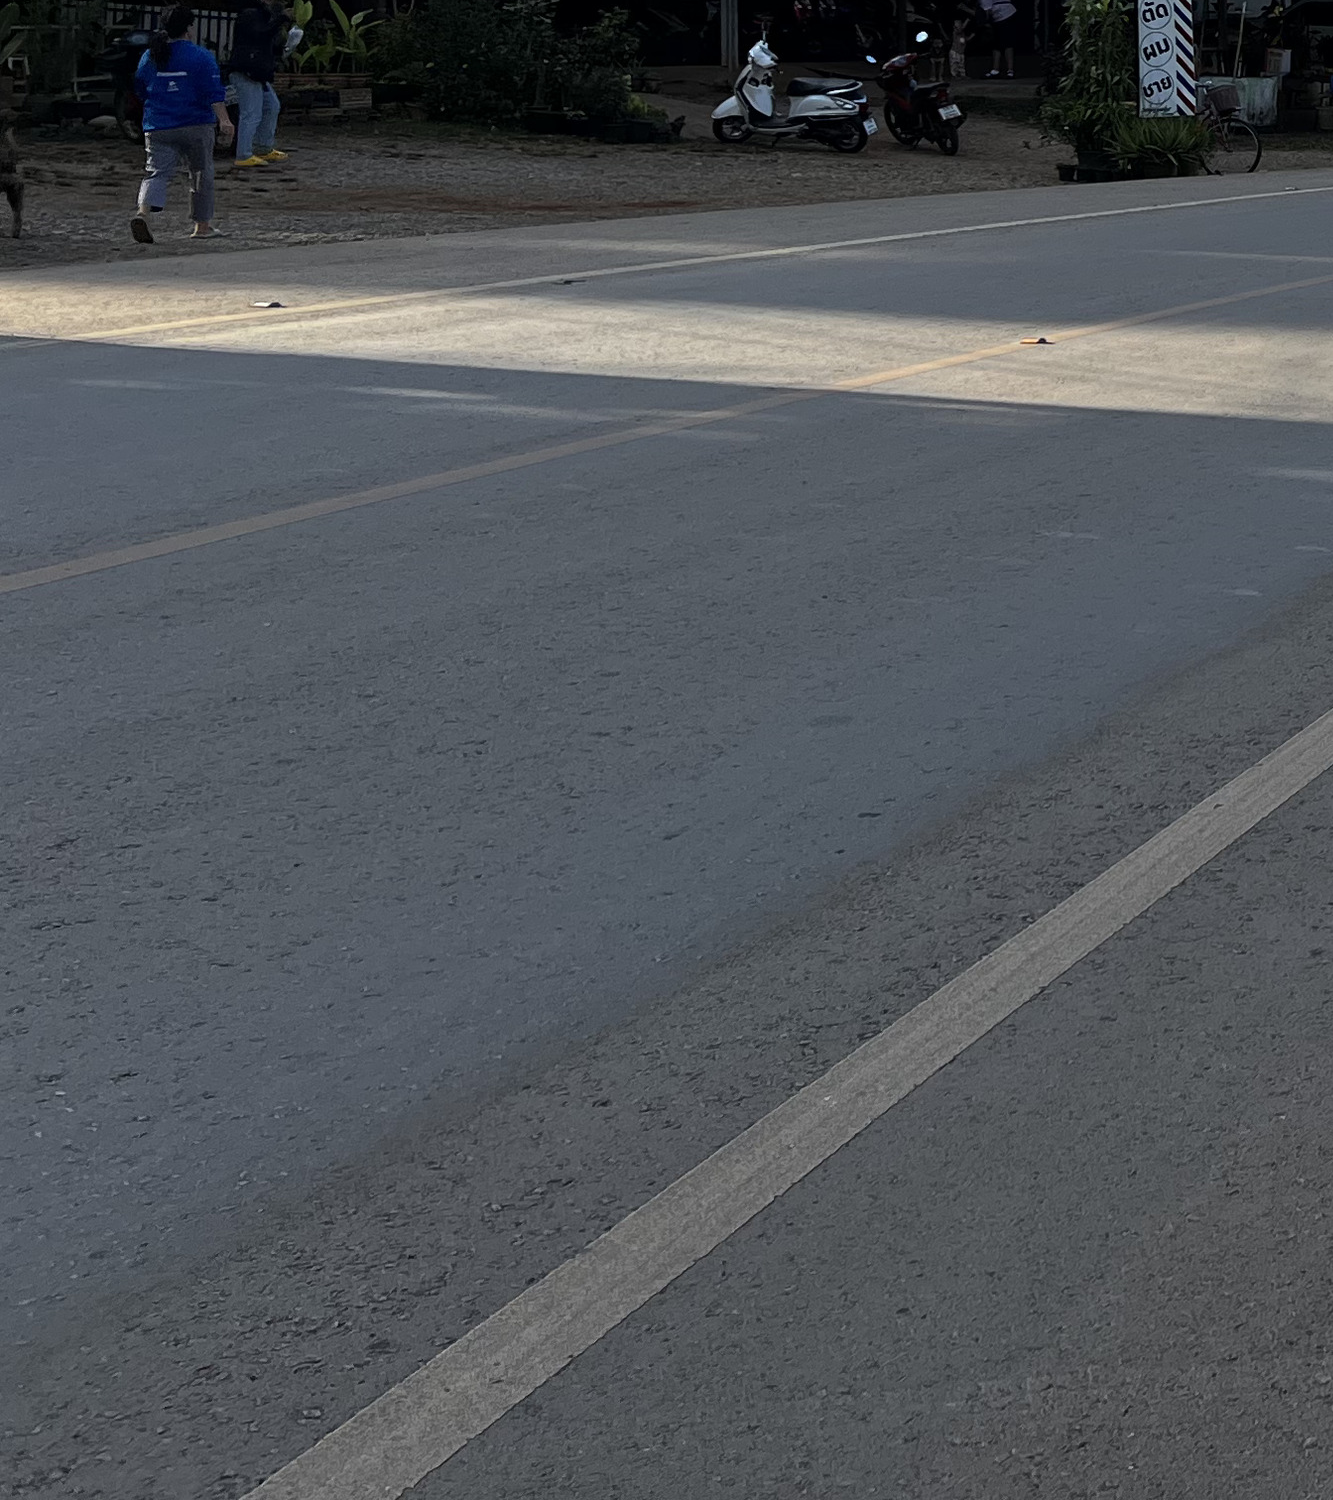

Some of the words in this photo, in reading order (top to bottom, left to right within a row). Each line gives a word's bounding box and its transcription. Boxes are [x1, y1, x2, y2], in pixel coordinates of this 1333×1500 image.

[1142, 1, 1169, 24] ตัด
[1142, 38, 1171, 62] ผม
[1143, 76, 1172, 98] ชาย
